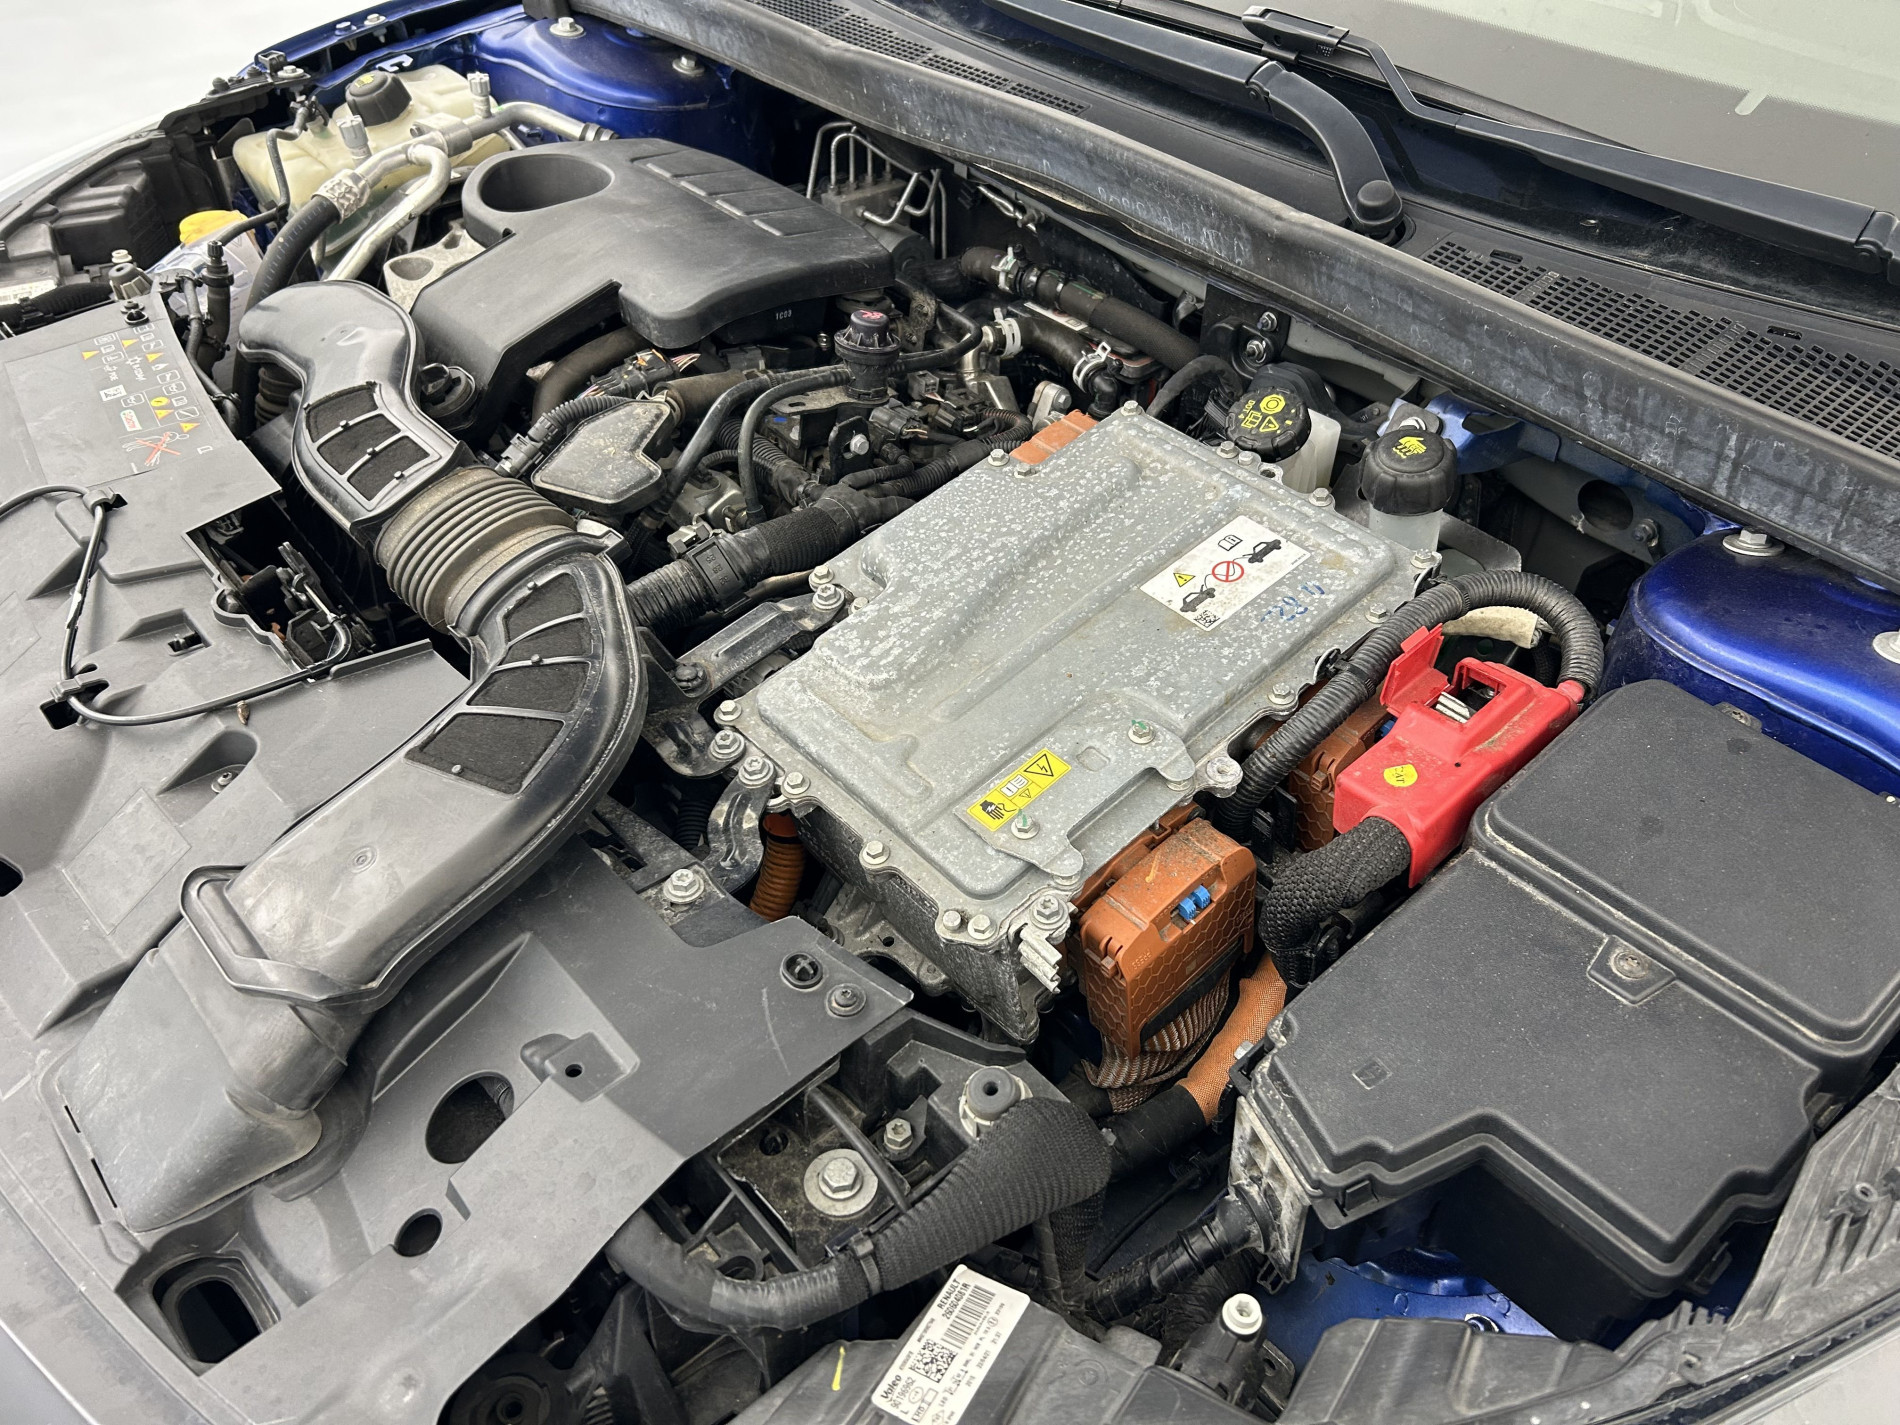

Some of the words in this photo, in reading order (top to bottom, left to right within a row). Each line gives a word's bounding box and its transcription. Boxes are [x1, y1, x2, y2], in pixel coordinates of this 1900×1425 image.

[1243, 400, 1255, 413] DOT
[937, 1278, 961, 1310] RENAULT
[881, 1375, 901, 1399] Valeo
